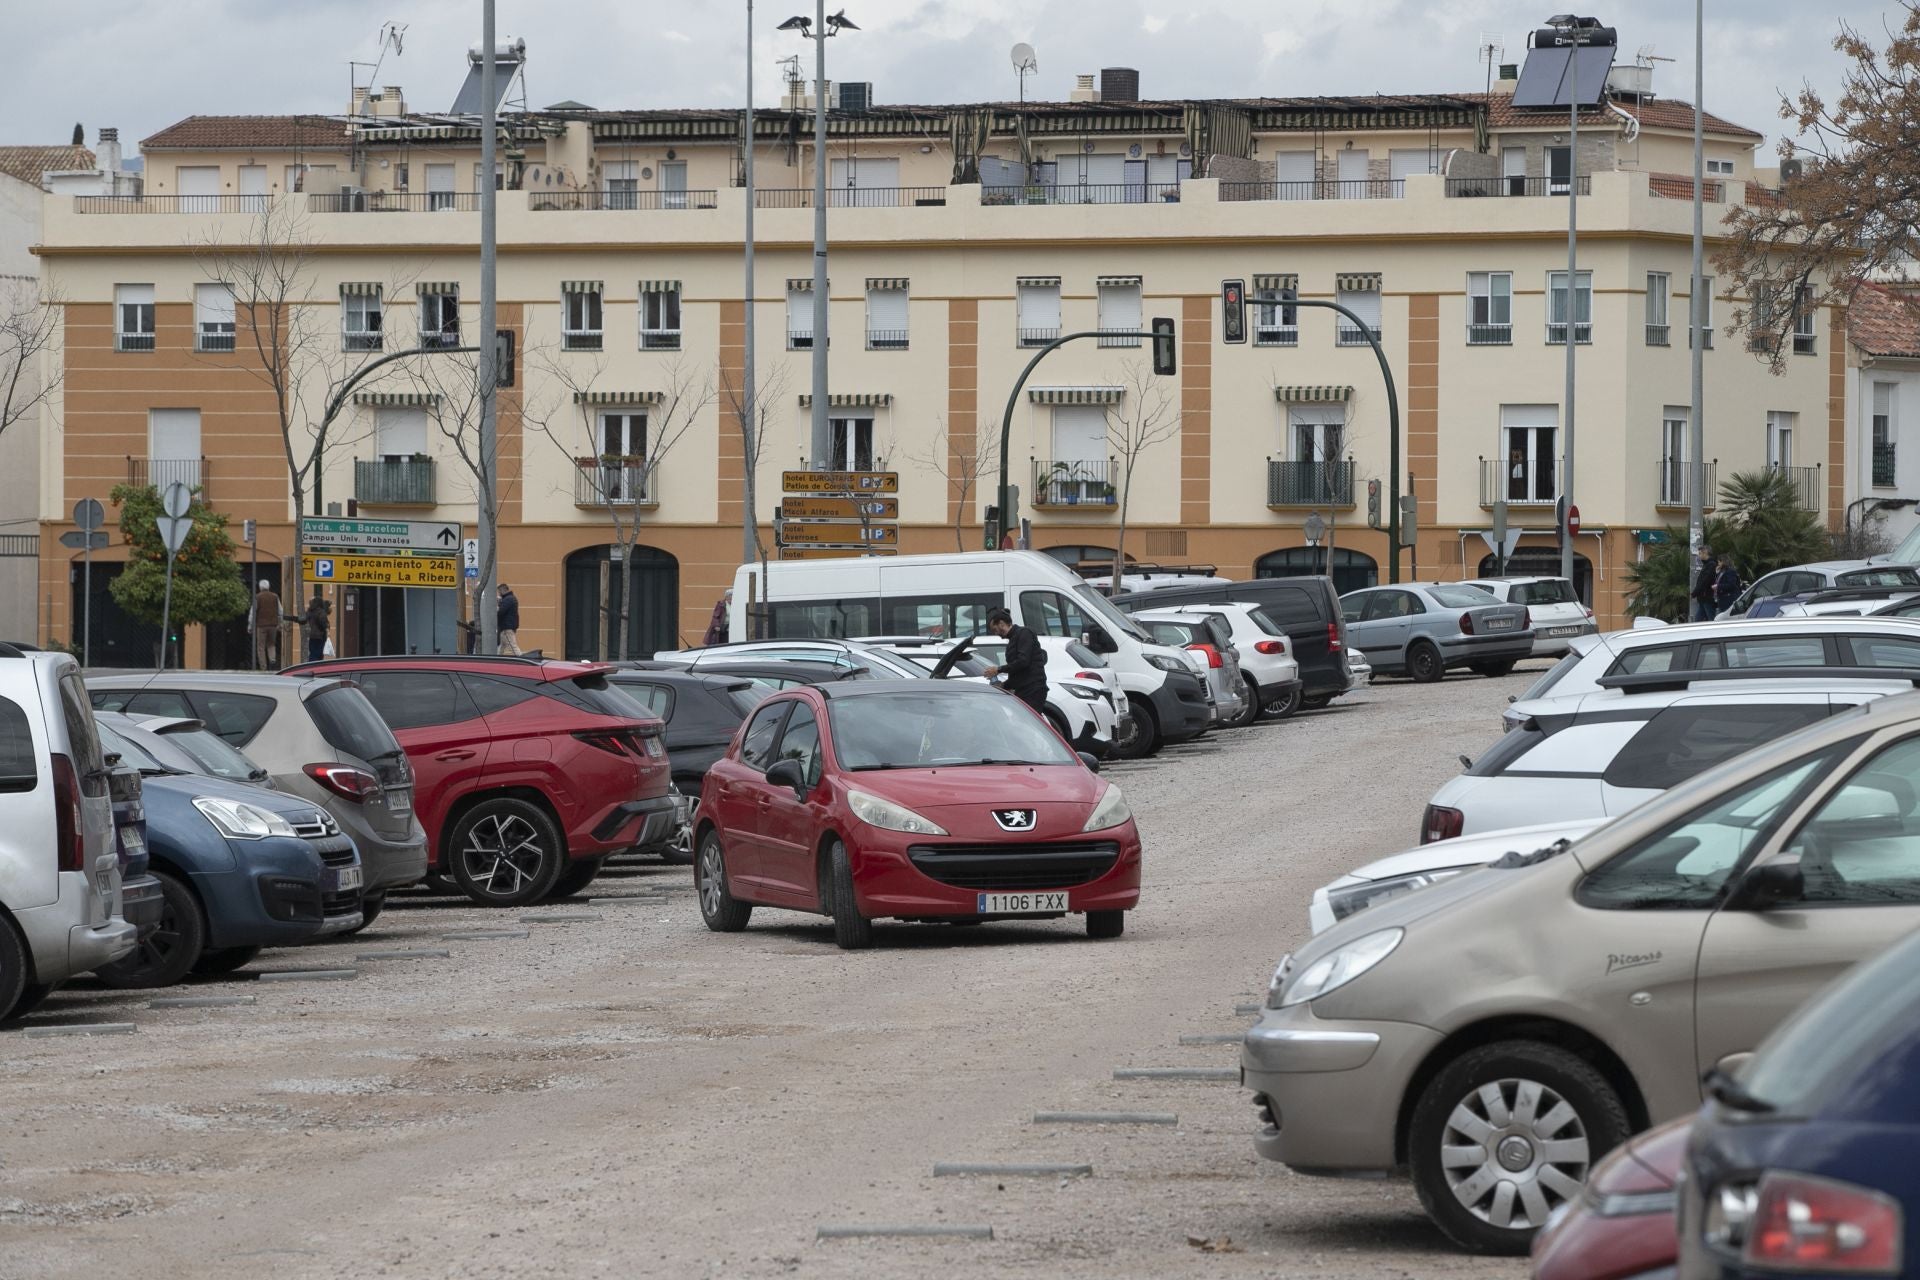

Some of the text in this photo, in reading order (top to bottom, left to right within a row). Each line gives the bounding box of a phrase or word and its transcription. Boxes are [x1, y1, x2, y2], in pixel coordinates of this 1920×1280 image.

[785, 474, 806, 482] hotel
[304, 522, 408, 534] Avda. de Barcelona
[303, 533, 335, 543] Campus
[366, 536, 411, 545] Rabanales
[318, 560, 331, 576] P
[343, 558, 456, 571] aparcamiento 24h.
[347, 571, 455, 583] parking La Ribera
[992, 895, 1030, 911] 1106
[1035, 893, 1065, 910] FXX
